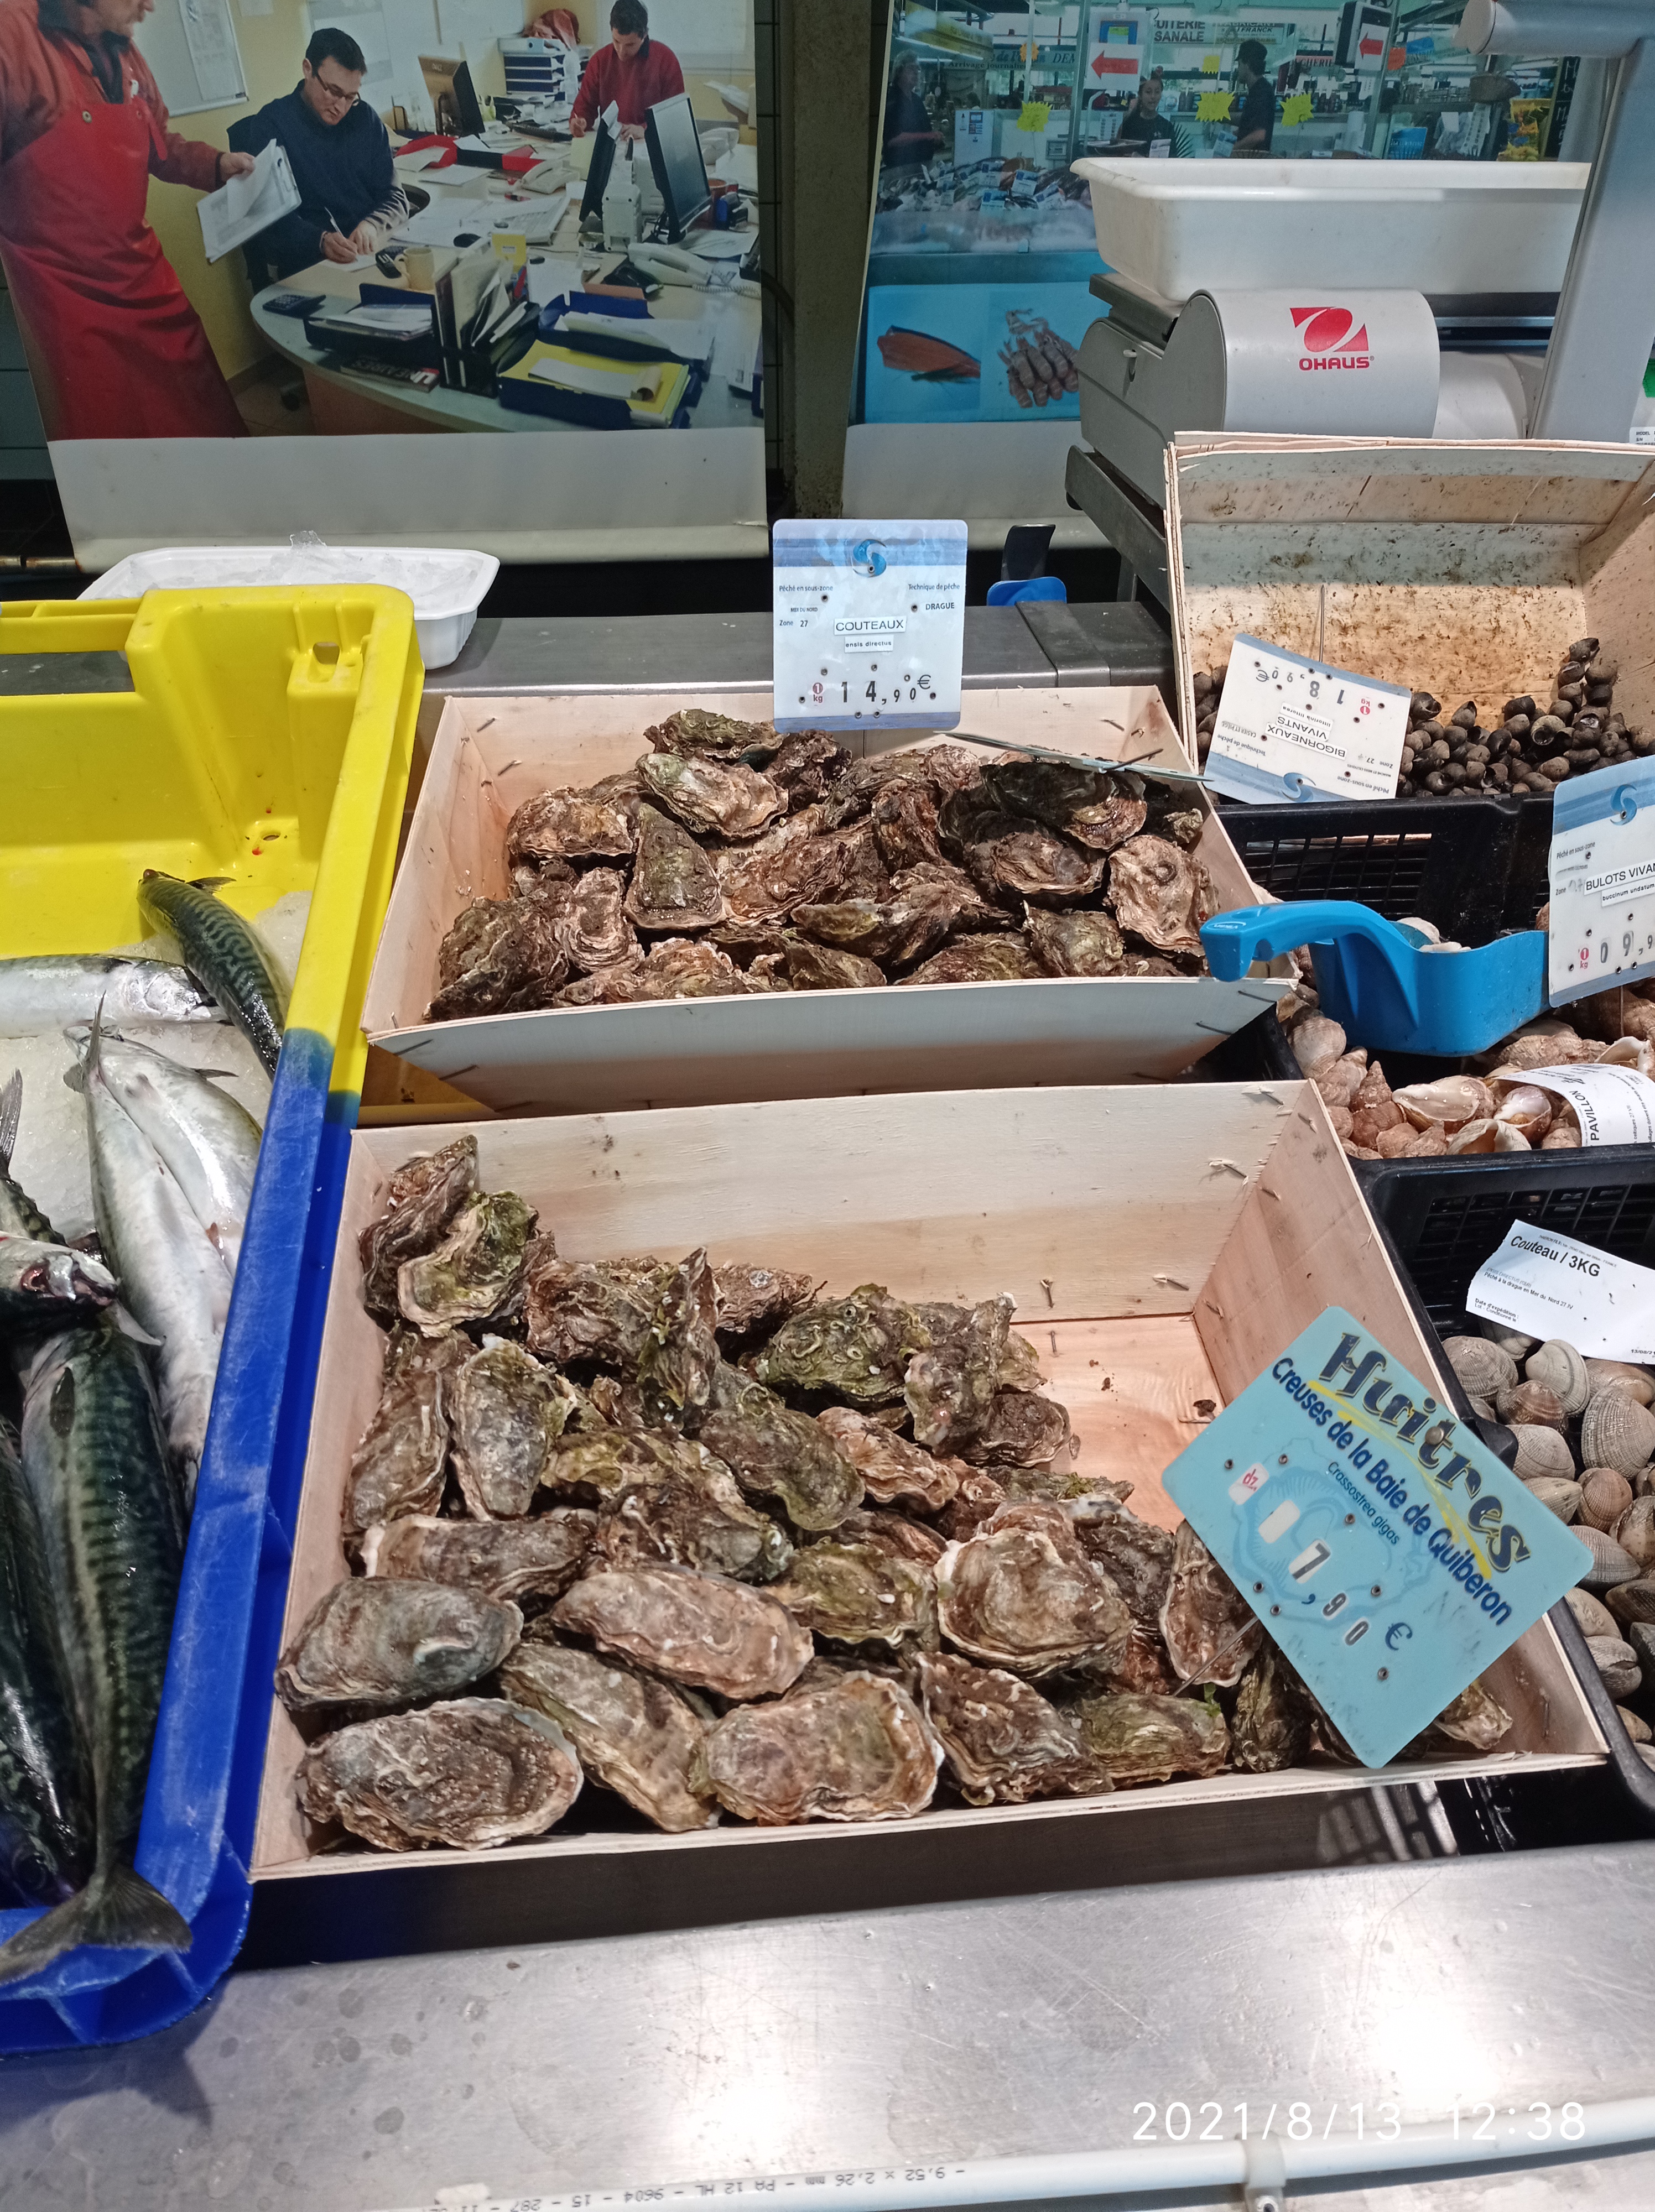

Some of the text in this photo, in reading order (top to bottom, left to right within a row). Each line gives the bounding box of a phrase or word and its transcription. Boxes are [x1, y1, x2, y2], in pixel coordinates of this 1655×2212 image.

[948, 61, 985, 70] Arrivage
[1299, 357, 1370, 371] OHAUS
[925, 602, 955, 611] DRAGUE
[836, 619, 904, 631] COUTEAUX
[813, 695, 823, 703] kg
[1361, 698, 1371, 707] kg
[1277, 716, 1327, 740] VIVANTS
[1267, 724, 1346, 758] BIGORNEAUX
[1241, 743, 1266, 757] Technique
[1586, 871, 1626, 891] BULOTS
[1555, 887, 1566, 895] Zone
[1602, 890, 1628, 901] buccinum
[1580, 961, 1588, 970] kg
[1570, 1090, 1600, 1140] PAVILLON
[1510, 1235, 1559, 1261] Couteau
[1569, 1255, 1601, 1277] 3KG
[1484, 1271, 1498, 1281] Pêché
[1507, 1280, 1522, 1291] drague
[1548, 1296, 1560, 1306] Nord
[1475, 1297, 1488, 1308] Date
[1319, 1332, 1531, 1572] Huitres
[1272, 1357, 1512, 1625] Creuses de la Baie de Quiberon
[1328, 1462, 1400, 1546] Crassostrea gigas
[695, 2184, 715, 2196] HL
[724, 2182, 743, 2194] 12
[755, 2179, 776, 2192] PA
[572, 2194, 591, 2208] 15
[624, 2188, 664, 2203] 9604
